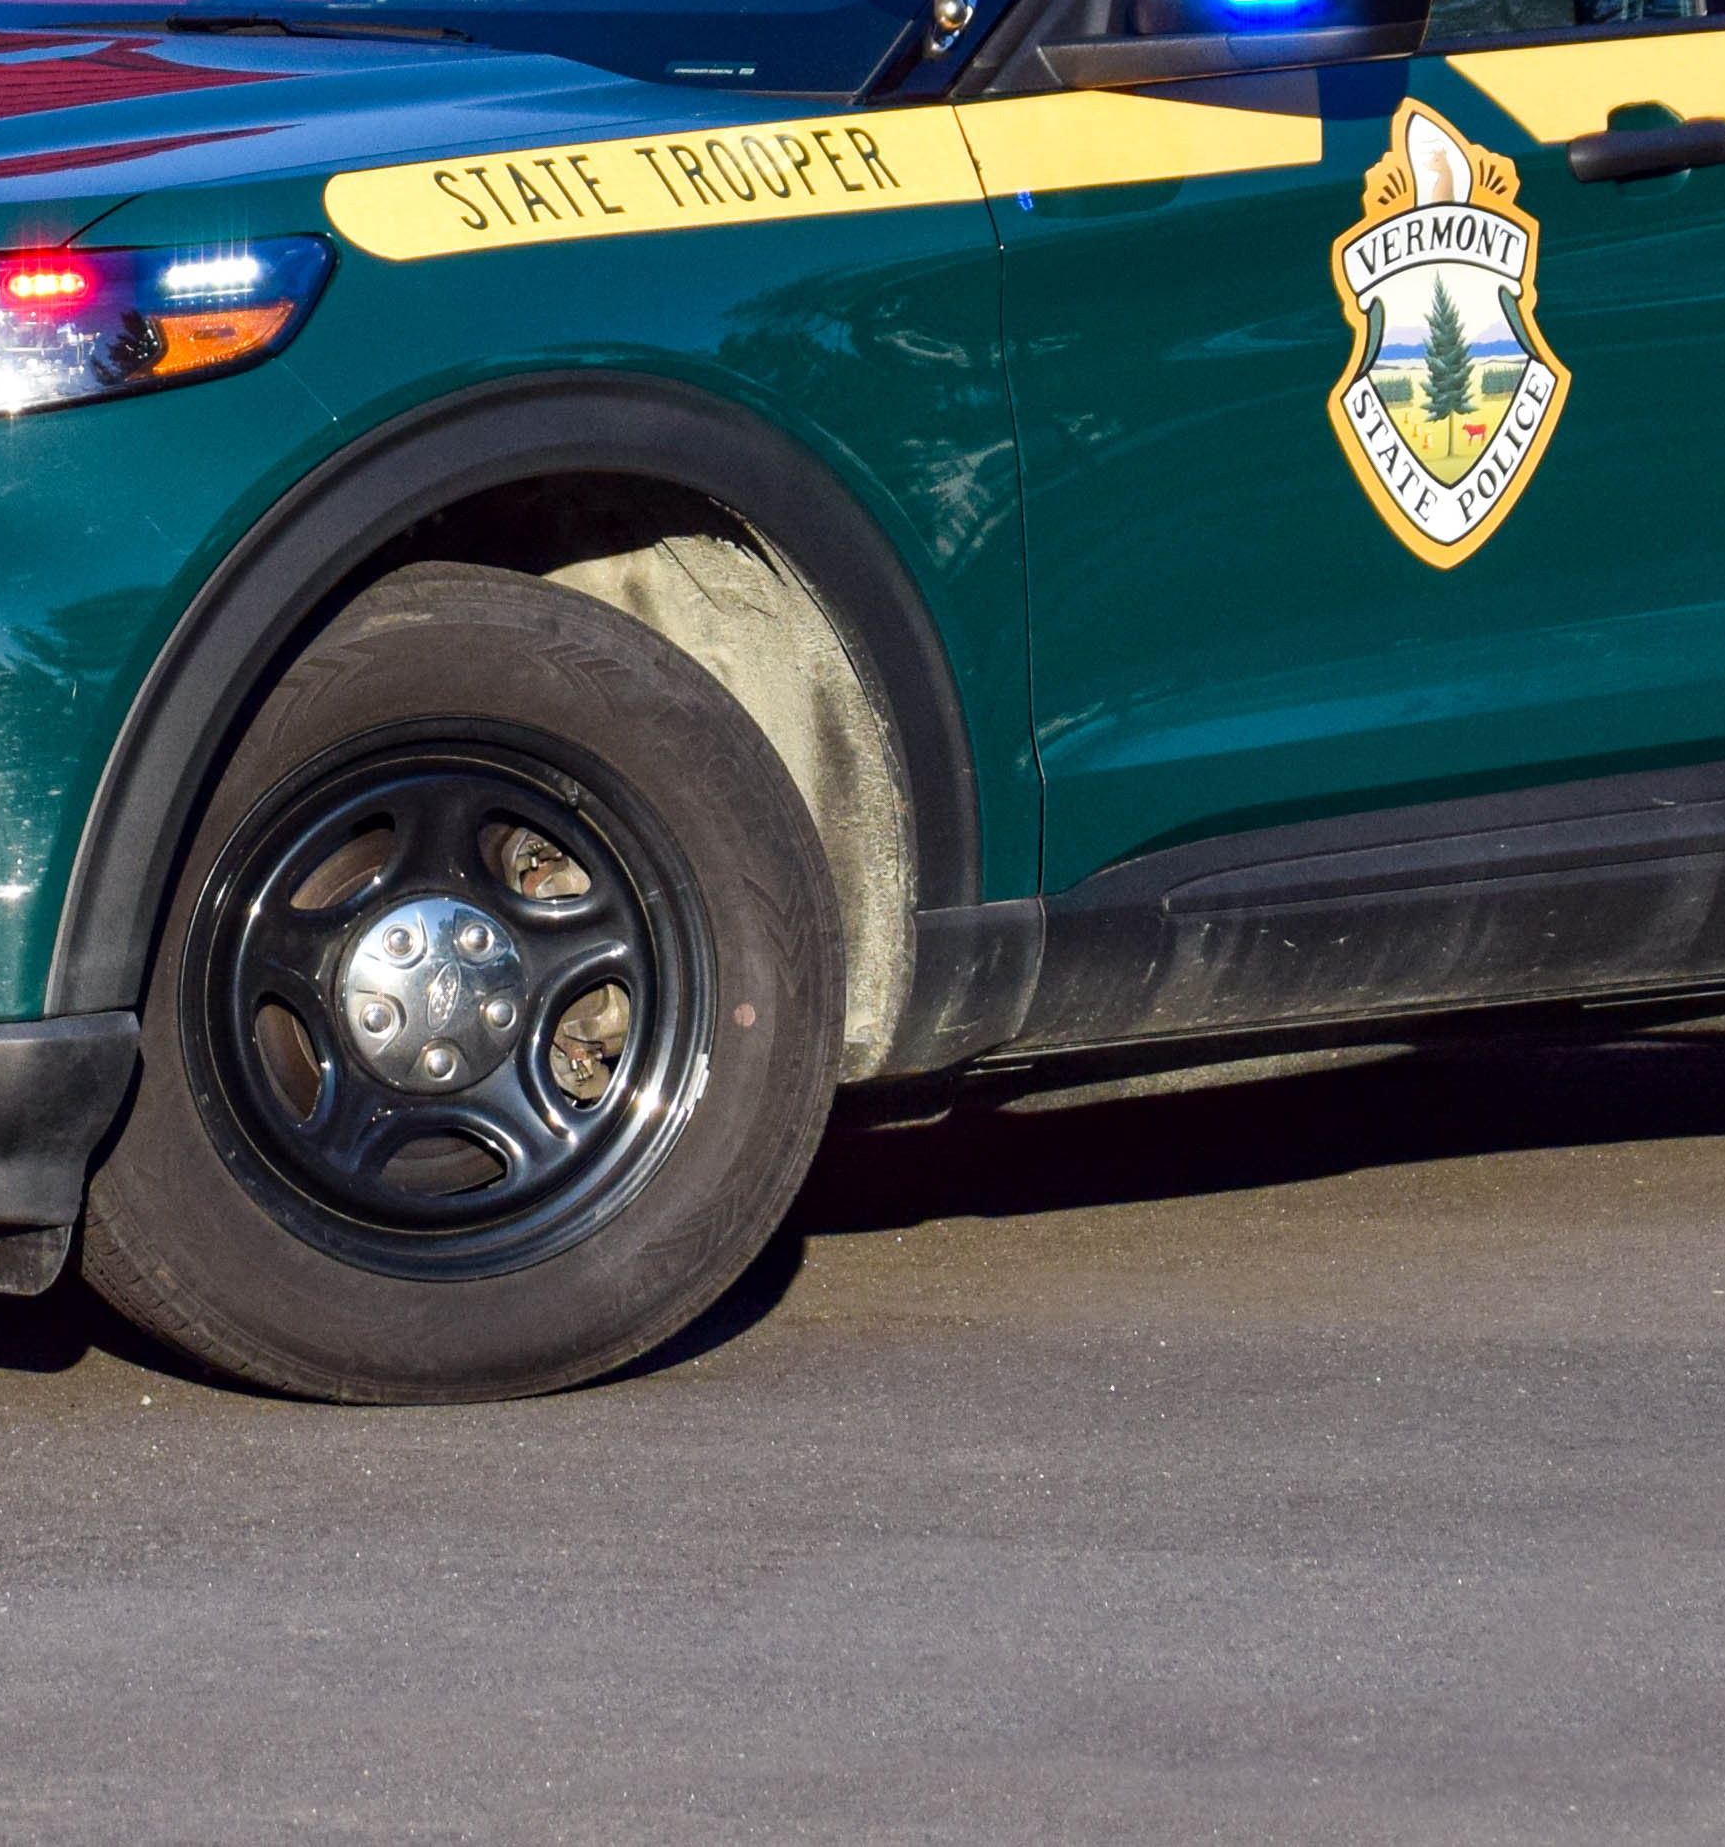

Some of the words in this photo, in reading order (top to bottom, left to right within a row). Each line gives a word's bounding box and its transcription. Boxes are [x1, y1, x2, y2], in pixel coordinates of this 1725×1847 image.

[433, 154, 624, 230] STATE
[636, 127, 901, 208] TROOPER
[1356, 215, 1520, 275] VERMONT
[1352, 390, 1440, 522] STATE
[1456, 373, 1551, 522] POLICE
